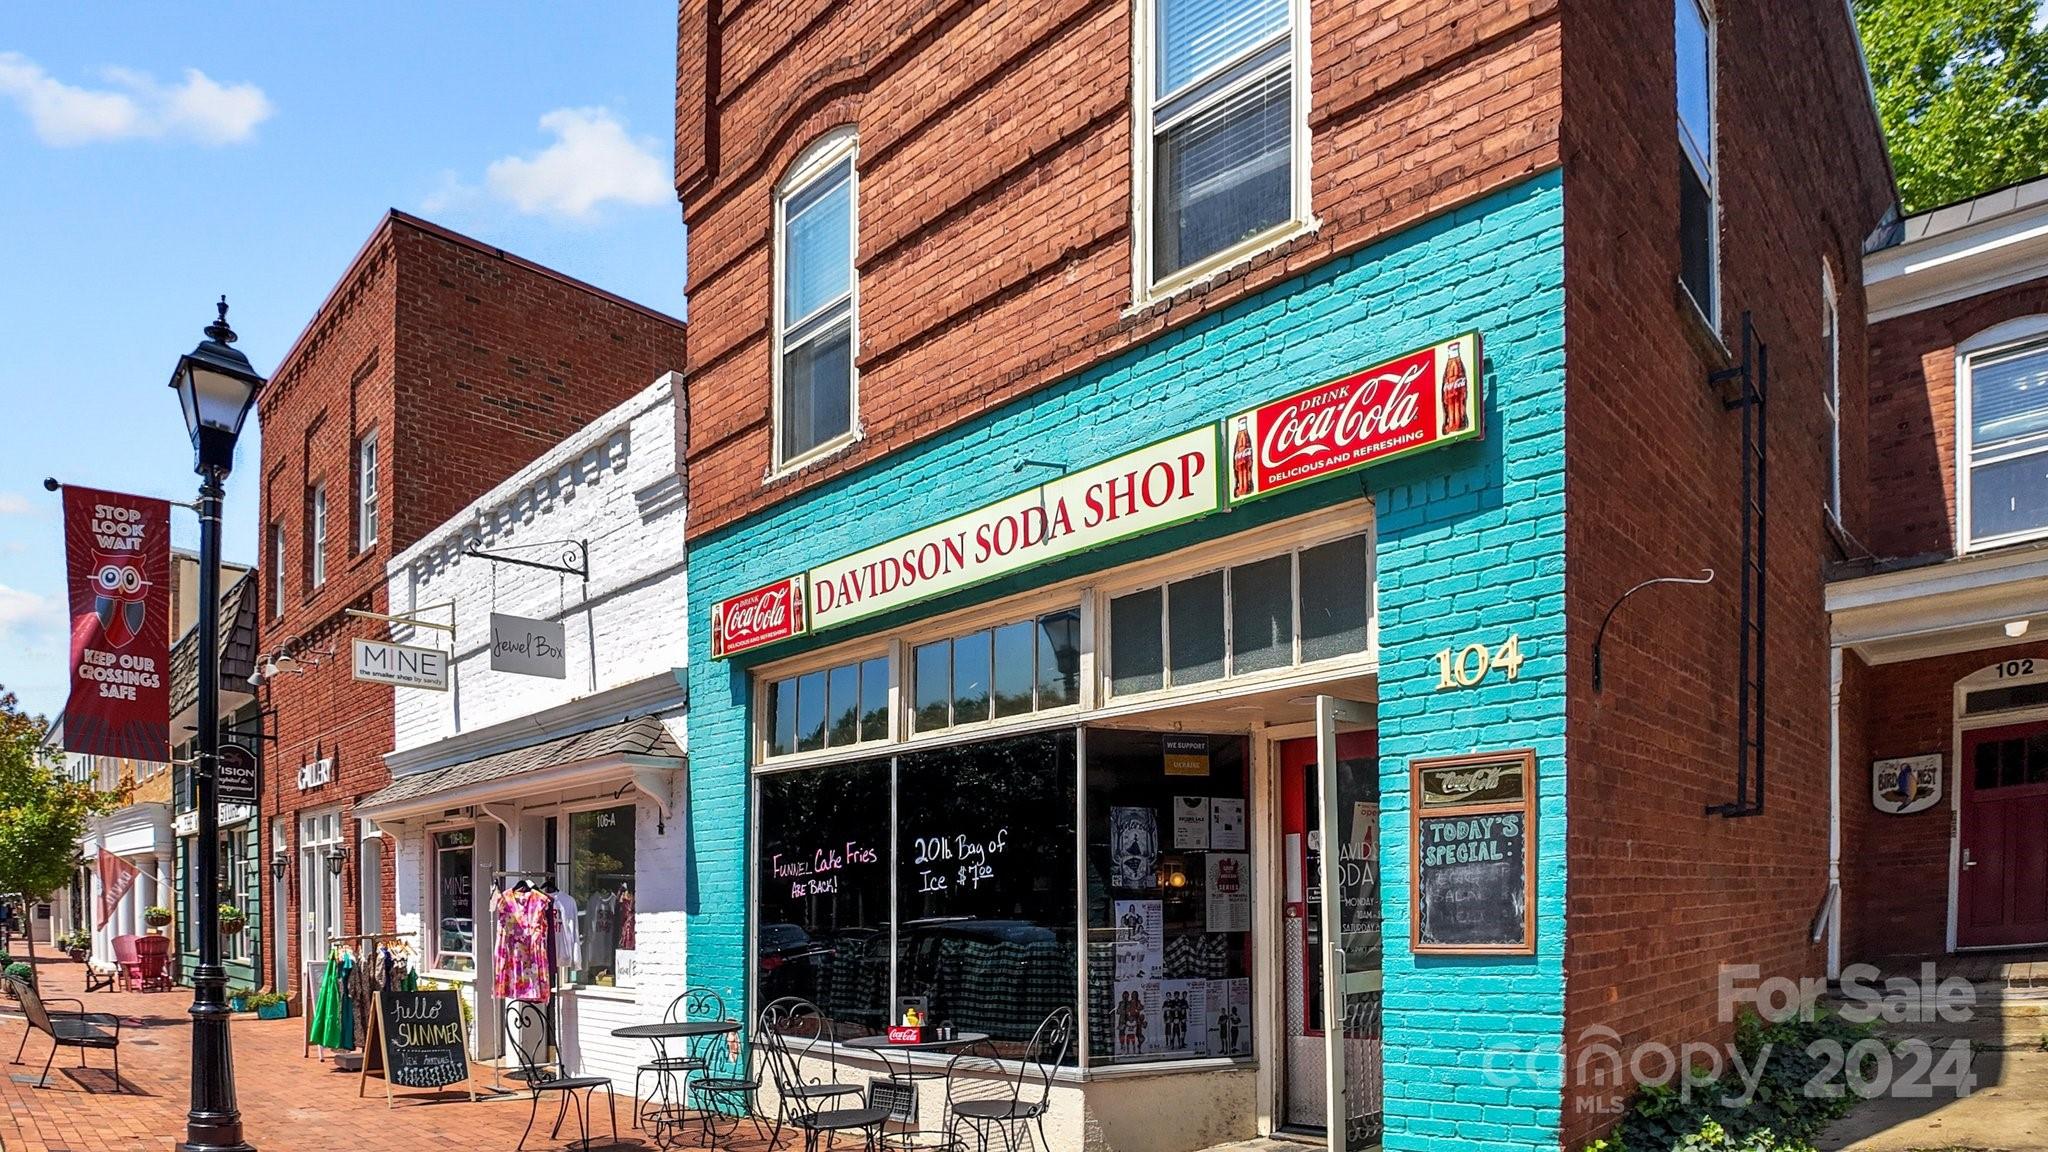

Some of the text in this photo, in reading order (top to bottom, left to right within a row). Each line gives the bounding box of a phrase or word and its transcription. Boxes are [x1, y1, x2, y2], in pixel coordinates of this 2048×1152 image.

[1300, 385, 1349, 412] DRINK
[1268, 429, 1424, 484] DELICIOUS AND REFRESHING
[95, 504, 141, 522] STOP
[91, 518, 145, 538] LOOK
[813, 451, 1206, 615] DAVIDSON SODA SHOP
[96, 534, 142, 550] WAIT
[739, 595, 760, 608] DRINK
[493, 628, 564, 659] Jewel Box
[727, 639, 750, 650] DELICIOUS
[760, 628, 788, 640] REFRESHING
[83, 649, 155, 672] KEEP OUR
[365, 645, 438, 676] MINE
[1435, 633, 1524, 691] 104
[1995, 659, 2034, 678] 102
[79, 664, 160, 688] CROSSINGS
[372, 671, 395, 679] smaller
[397, 673, 413, 682] shop
[414, 675, 422, 683] by
[423, 677, 443, 686] sandy
[100, 682, 137, 701] SAFE
[1177, 742, 1205, 750] SUPPORT
[596, 812, 616, 828] 106-A
[1429, 814, 1519, 843] TODAY'S
[814, 848, 842, 873] Cake
[846, 841, 878, 865] Fries
[956, 834, 985, 867] Bag
[989, 828, 1008, 853] of
[918, 870, 948, 892] Ice
[1317, 861, 1375, 887] ODA
[791, 882, 807, 898] ARE
[1345, 897, 1374, 907] MONDAY
[1342, 923, 1375, 933] SATURDAY
[390, 996, 442, 1022] hello
[392, 1022, 462, 1048] SUMMER
